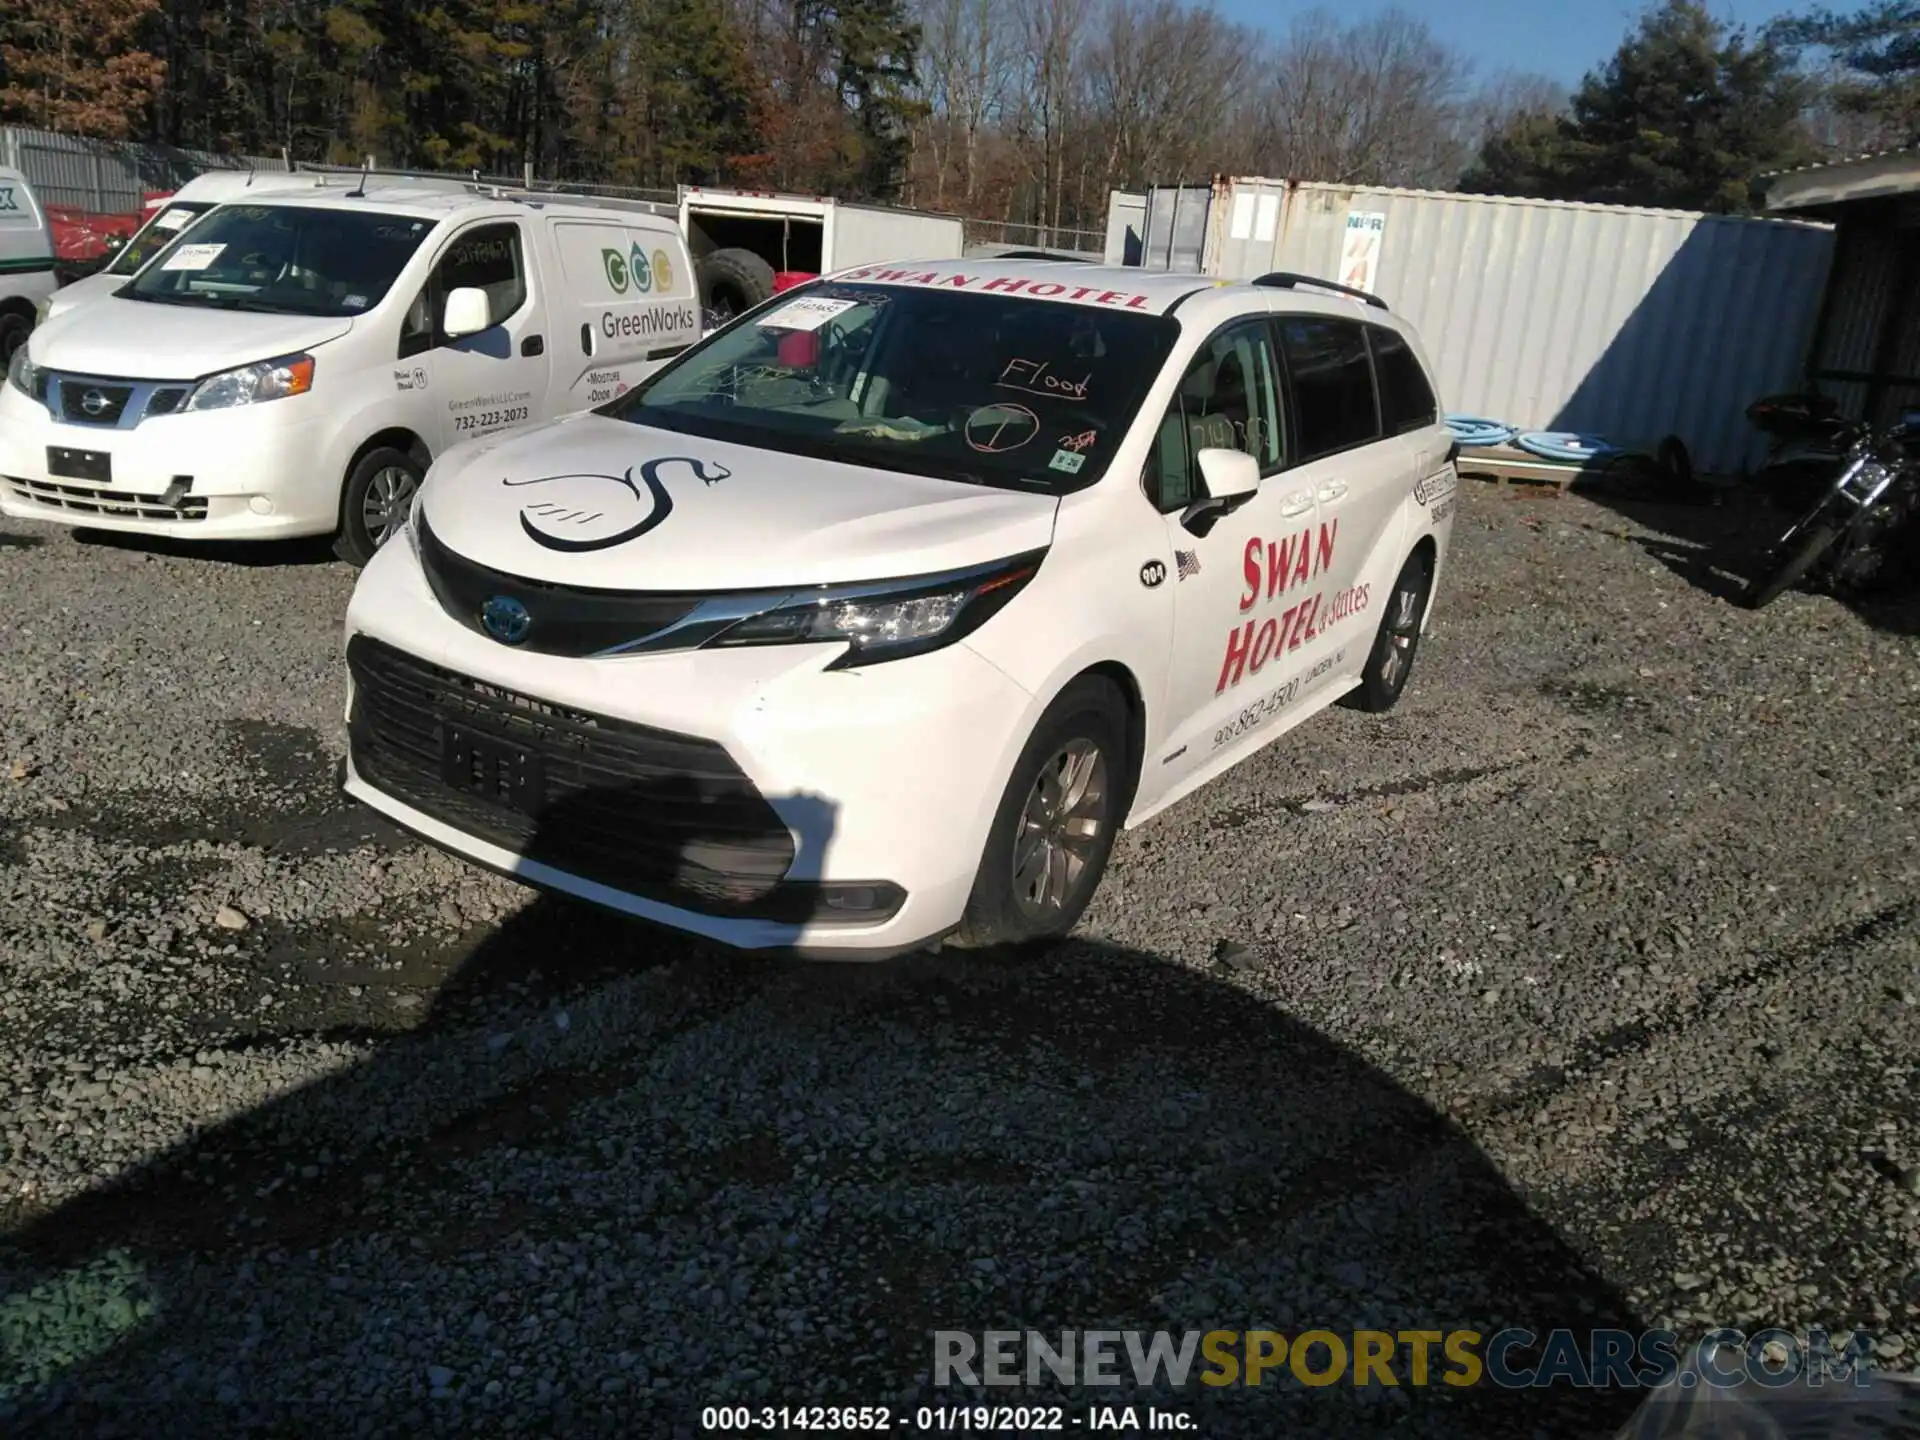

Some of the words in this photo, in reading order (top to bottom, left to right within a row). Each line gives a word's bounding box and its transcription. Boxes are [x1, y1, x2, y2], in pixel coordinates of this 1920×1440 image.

[844, 267, 980, 287] SWAN
[983, 277, 1149, 309] HOTEL
[602, 305, 694, 338] GreenWorks
[455, 406, 528, 431] 732-223-2073
[1143, 564, 1164, 585] 904
[1239, 517, 1338, 614] SWAN
[1215, 591, 1322, 697] HOTEL
[1328, 582, 1371, 628] Suites
